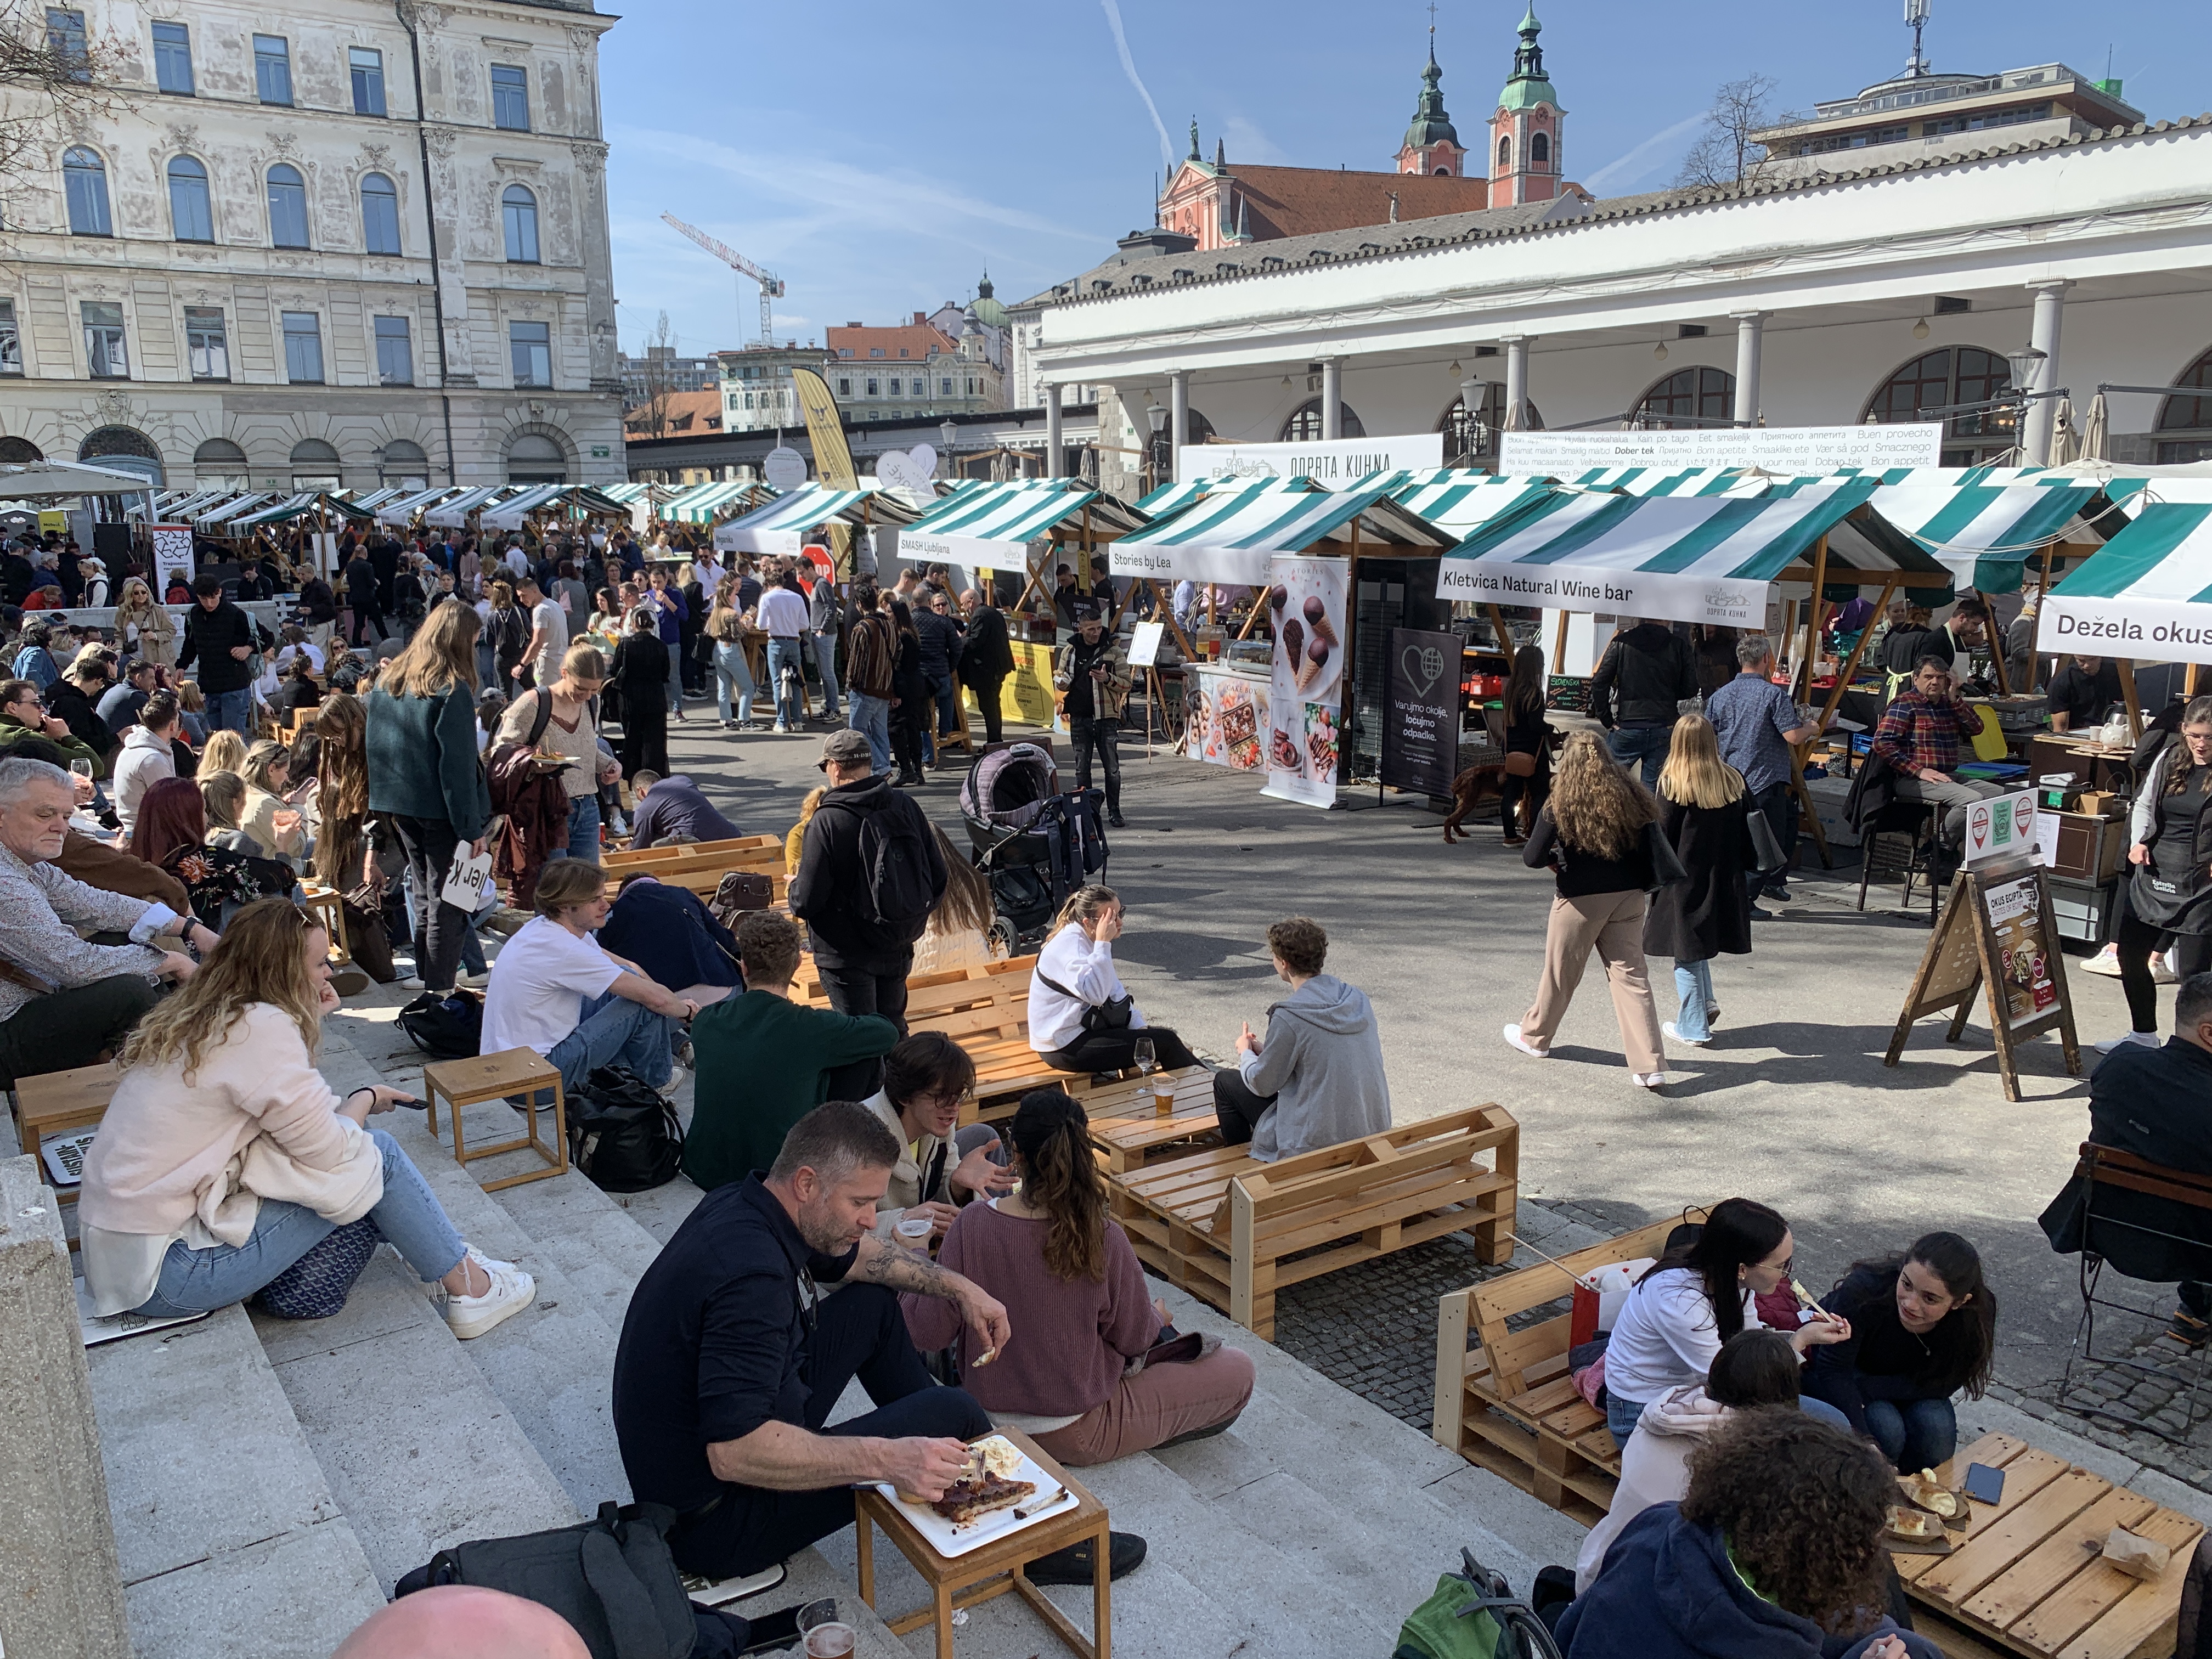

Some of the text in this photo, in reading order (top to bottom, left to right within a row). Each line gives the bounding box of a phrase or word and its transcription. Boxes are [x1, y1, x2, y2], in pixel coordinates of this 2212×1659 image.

[1590, 435, 1628, 443] ruokahalua
[1638, 435, 1652, 443] Kain
[1657, 436, 1667, 444] po
[1672, 435, 1689, 444] tayo
[1717, 433, 1751, 443] smakelijk
[1762, 431, 1846, 441] Приятного аппетита
[1858, 429, 1933, 440] Buen provecho
[1508, 447, 1533, 455] Selamat
[1561, 447, 1586, 456] Smaklig
[1615, 447, 1639, 455] Dober
[1641, 446, 1654, 454] tek
[1717, 446, 1746, 455] apetite
[1752, 445, 1792, 454] Smaaklike
[1837, 443, 1847, 453] så
[1850, 443, 1869, 454] god
[1875, 443, 1931, 453] Smacznego
[1346, 454, 1390, 477] KUHNA
[1506, 458, 1515, 466] Ha
[1518, 458, 1529, 466] kuu
[1532, 458, 1574, 466] macaanaato
[1580, 458, 1624, 466] Velbekomme
[1630, 458, 1658, 466] Dobrou
[1686, 458, 1730, 466] いただきます
[1738, 458, 1759, 468] Enjoy
[1763, 459, 1782, 468] your
[1786, 457, 1807, 466] meal
[1848, 456, 1862, 465] tek
[1871, 456, 1889, 465] Bon
[1894, 455, 1930, 467] appétit
[716, 535, 733, 545] Veganika
[901, 539, 950, 556] SMASH Ljubljana
[1114, 553, 1171, 570] Stories by Lea
[815, 564, 830, 578] OP
[1443, 571, 1633, 601] Kletvica Natural Wine bar
[1729, 610, 1746, 619] KUHNA
[2057, 614, 2143, 640] Dežela
[1013, 656, 1034, 665] URGERS
[1226, 684, 1258, 695] CAKE BOX
[1395, 699, 1448, 718] Varujmo okolje,
[1406, 714, 1435, 728] ločujmo
[1403, 727, 1437, 741] odpadke.
[2152, 879, 2176, 889] Estrella
[1991, 896, 2005, 909] OKUS
[1993, 906, 2006, 917] TASTES
